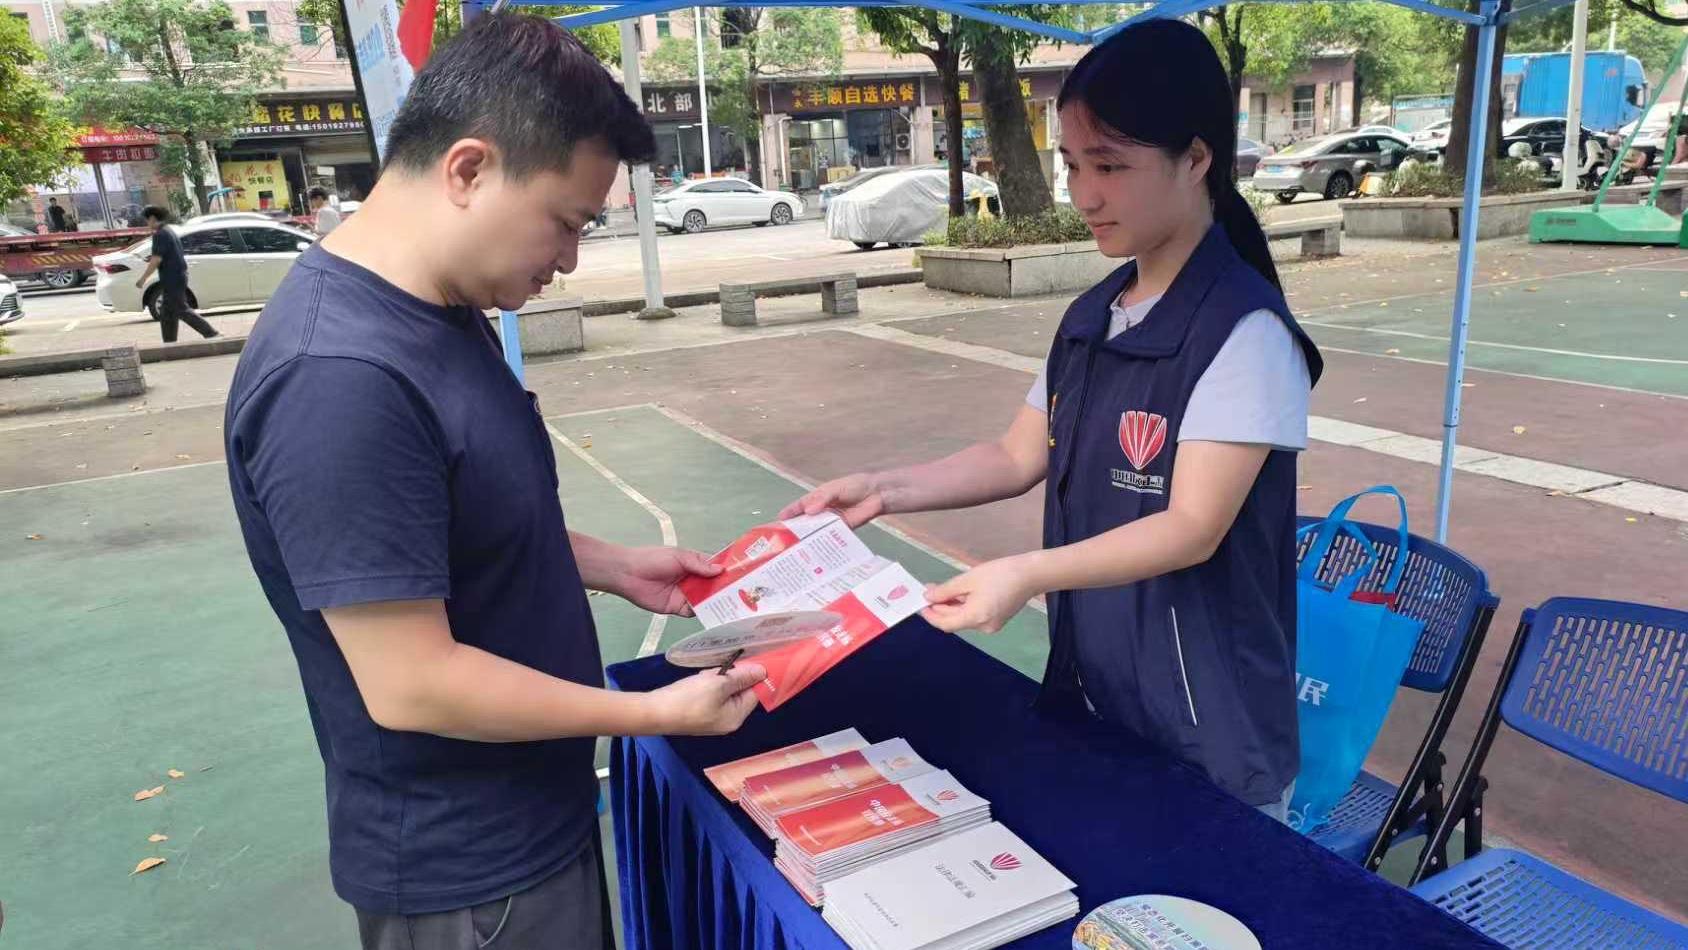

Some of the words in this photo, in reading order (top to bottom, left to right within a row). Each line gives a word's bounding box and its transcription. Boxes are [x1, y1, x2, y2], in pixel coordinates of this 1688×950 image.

[808, 83, 914, 106] 丰顺自选快餐
